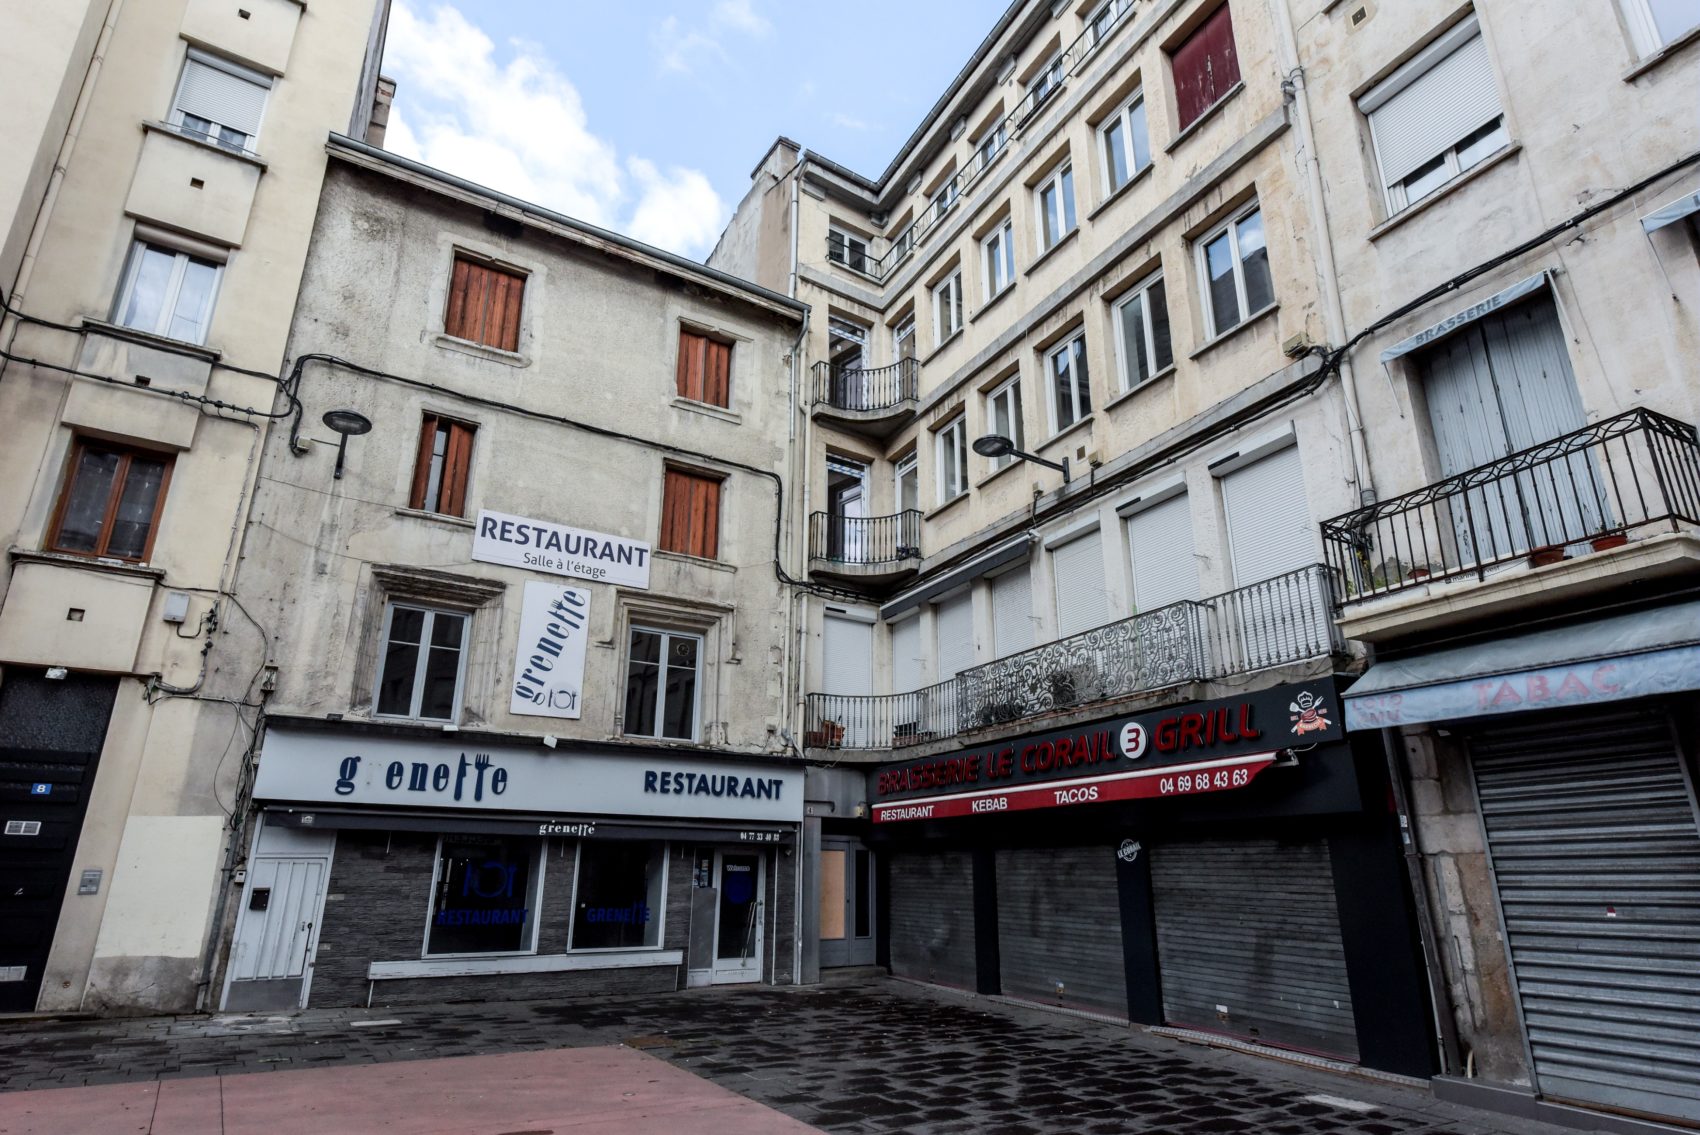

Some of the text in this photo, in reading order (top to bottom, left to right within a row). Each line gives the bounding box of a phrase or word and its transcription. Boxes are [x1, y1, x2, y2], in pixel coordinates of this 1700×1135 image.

[1415, 294, 1502, 345] BRASSERIE
[480, 516, 649, 567] RESTAURANT
[523, 552, 607, 579] Salle à l'étage
[1471, 664, 1619, 709] TABAC
[878, 703, 1261, 795] BRASSERIE LE CORAIL 3 GRILL
[36, 784, 46, 793] 8
[644, 770, 783, 800] RESTAURANT
[1160, 768, 1248, 794] 04 69 68 43 63
[972, 798, 1008, 812] KEBAB
[1054, 786, 1098, 804] TACOS
[880, 805, 935, 821] RESTAURANT
[748, 832, 755, 840] 77
[436, 908, 529, 926] RESTAURANT
